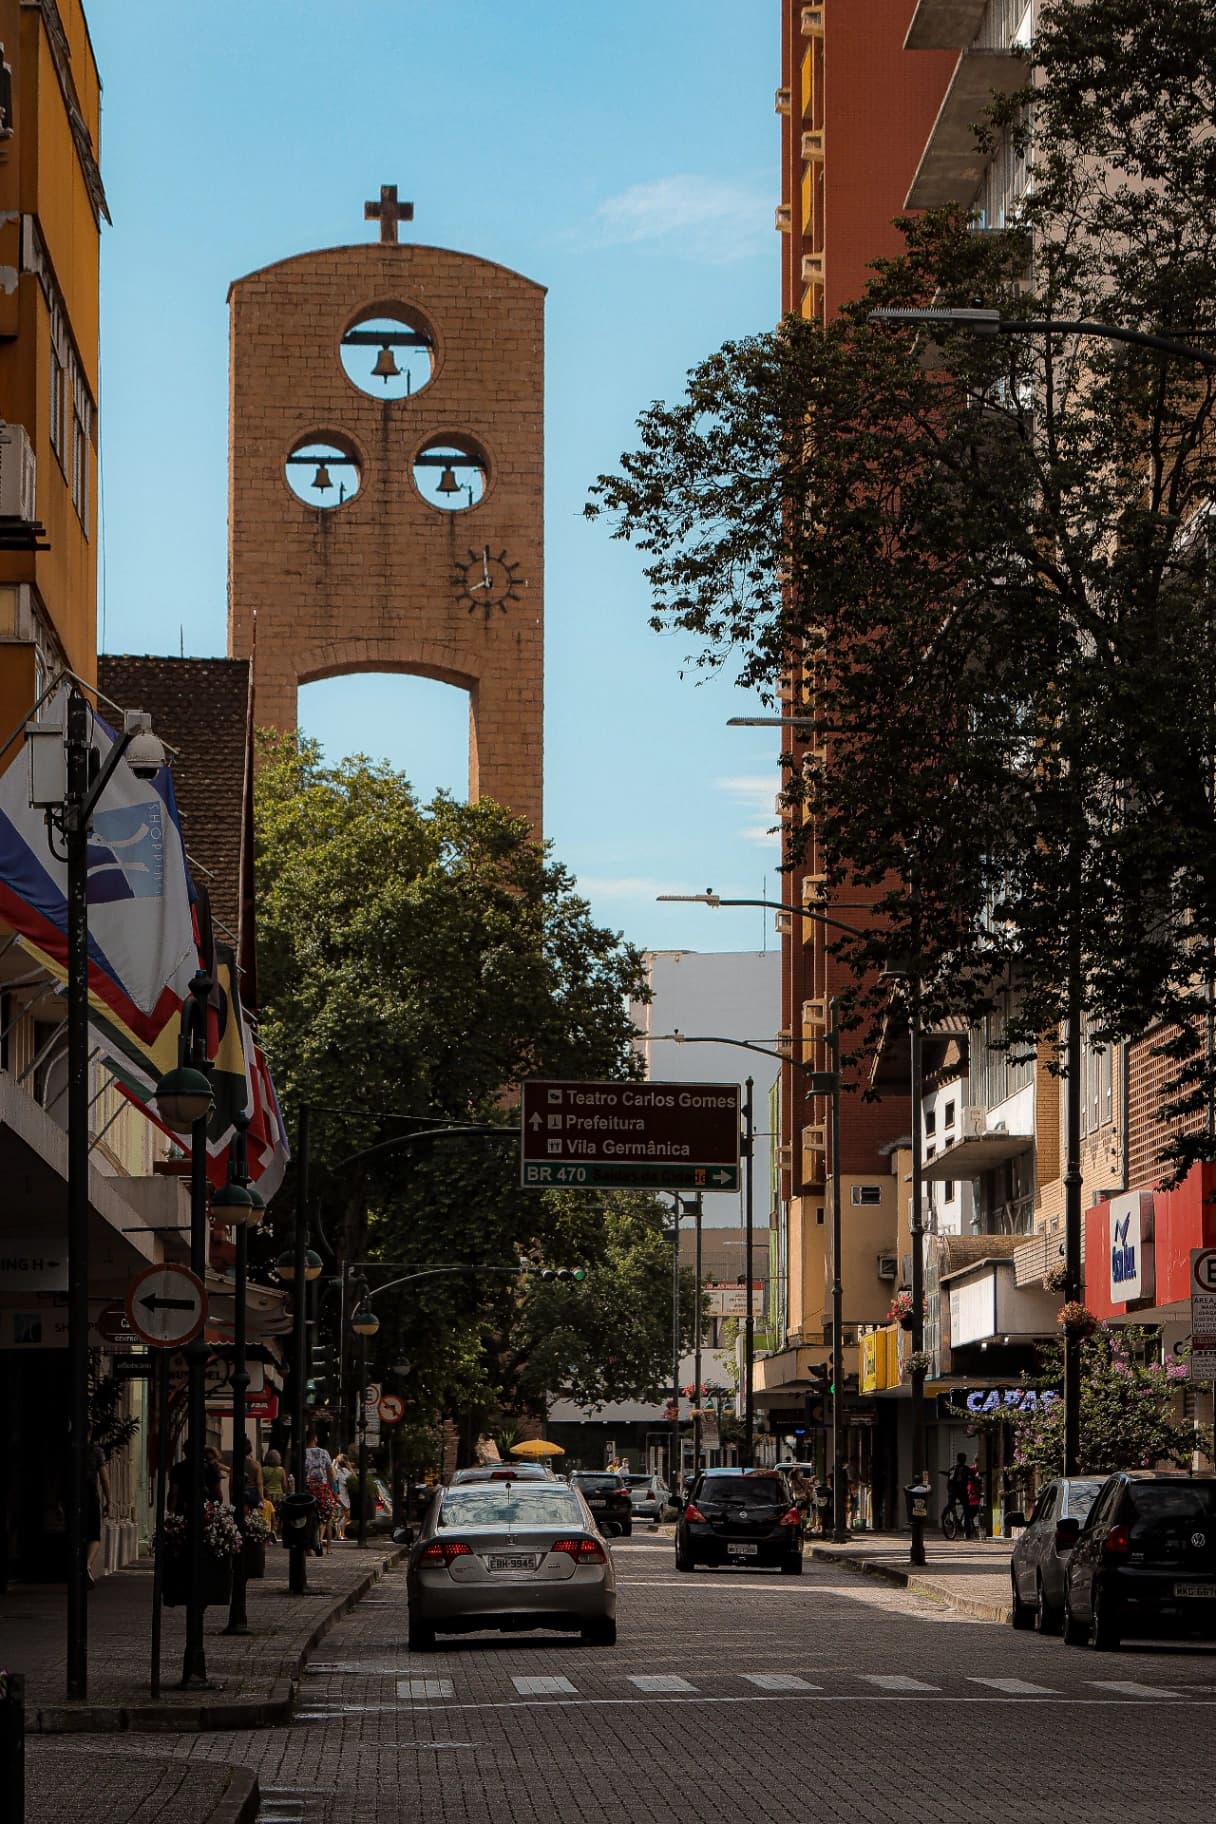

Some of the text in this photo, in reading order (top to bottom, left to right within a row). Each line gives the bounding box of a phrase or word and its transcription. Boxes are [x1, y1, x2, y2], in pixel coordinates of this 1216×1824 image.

[566, 1090, 737, 1109] Teatro Carlos Gomes
[566, 1115, 645, 1131] Prefeitura
[566, 1139, 690, 1157] Vila Germânica
[527, 1167, 552, 1181] BR
[556, 1167, 586, 1182] 470
